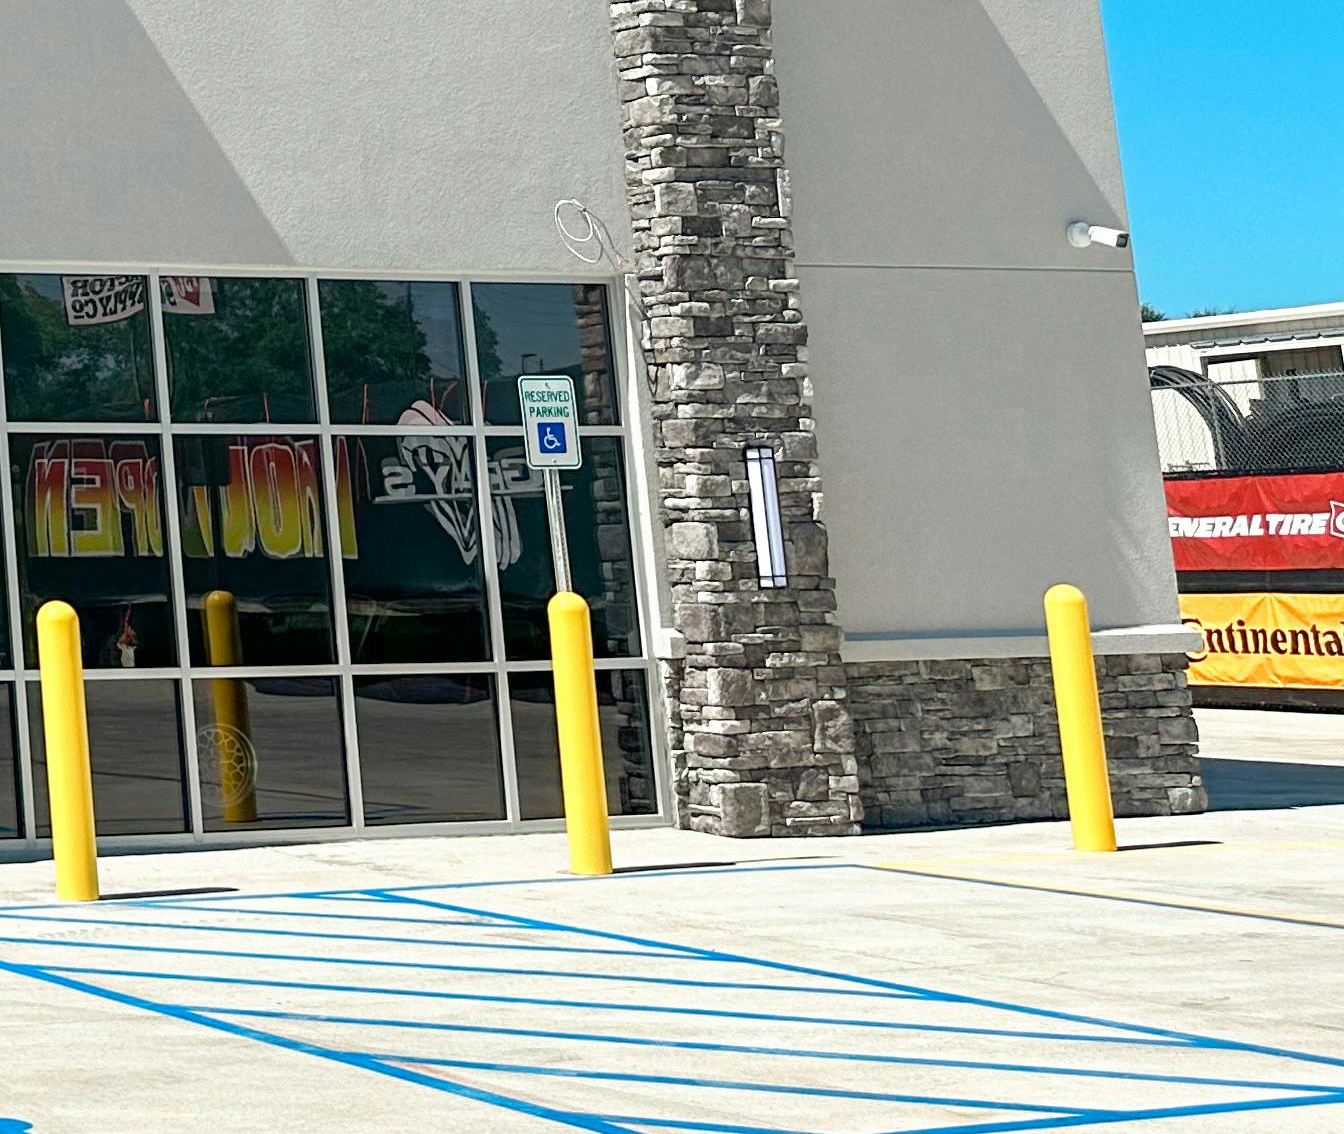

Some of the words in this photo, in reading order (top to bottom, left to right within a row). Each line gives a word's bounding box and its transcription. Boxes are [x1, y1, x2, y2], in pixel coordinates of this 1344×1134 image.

[524, 390, 570, 403] RESERVED
[529, 406, 570, 418] PARKING
[1168, 514, 1265, 538] ENERAL
[1265, 512, 1331, 536] TIRE
[1181, 618, 1344, 662] ntinenta
